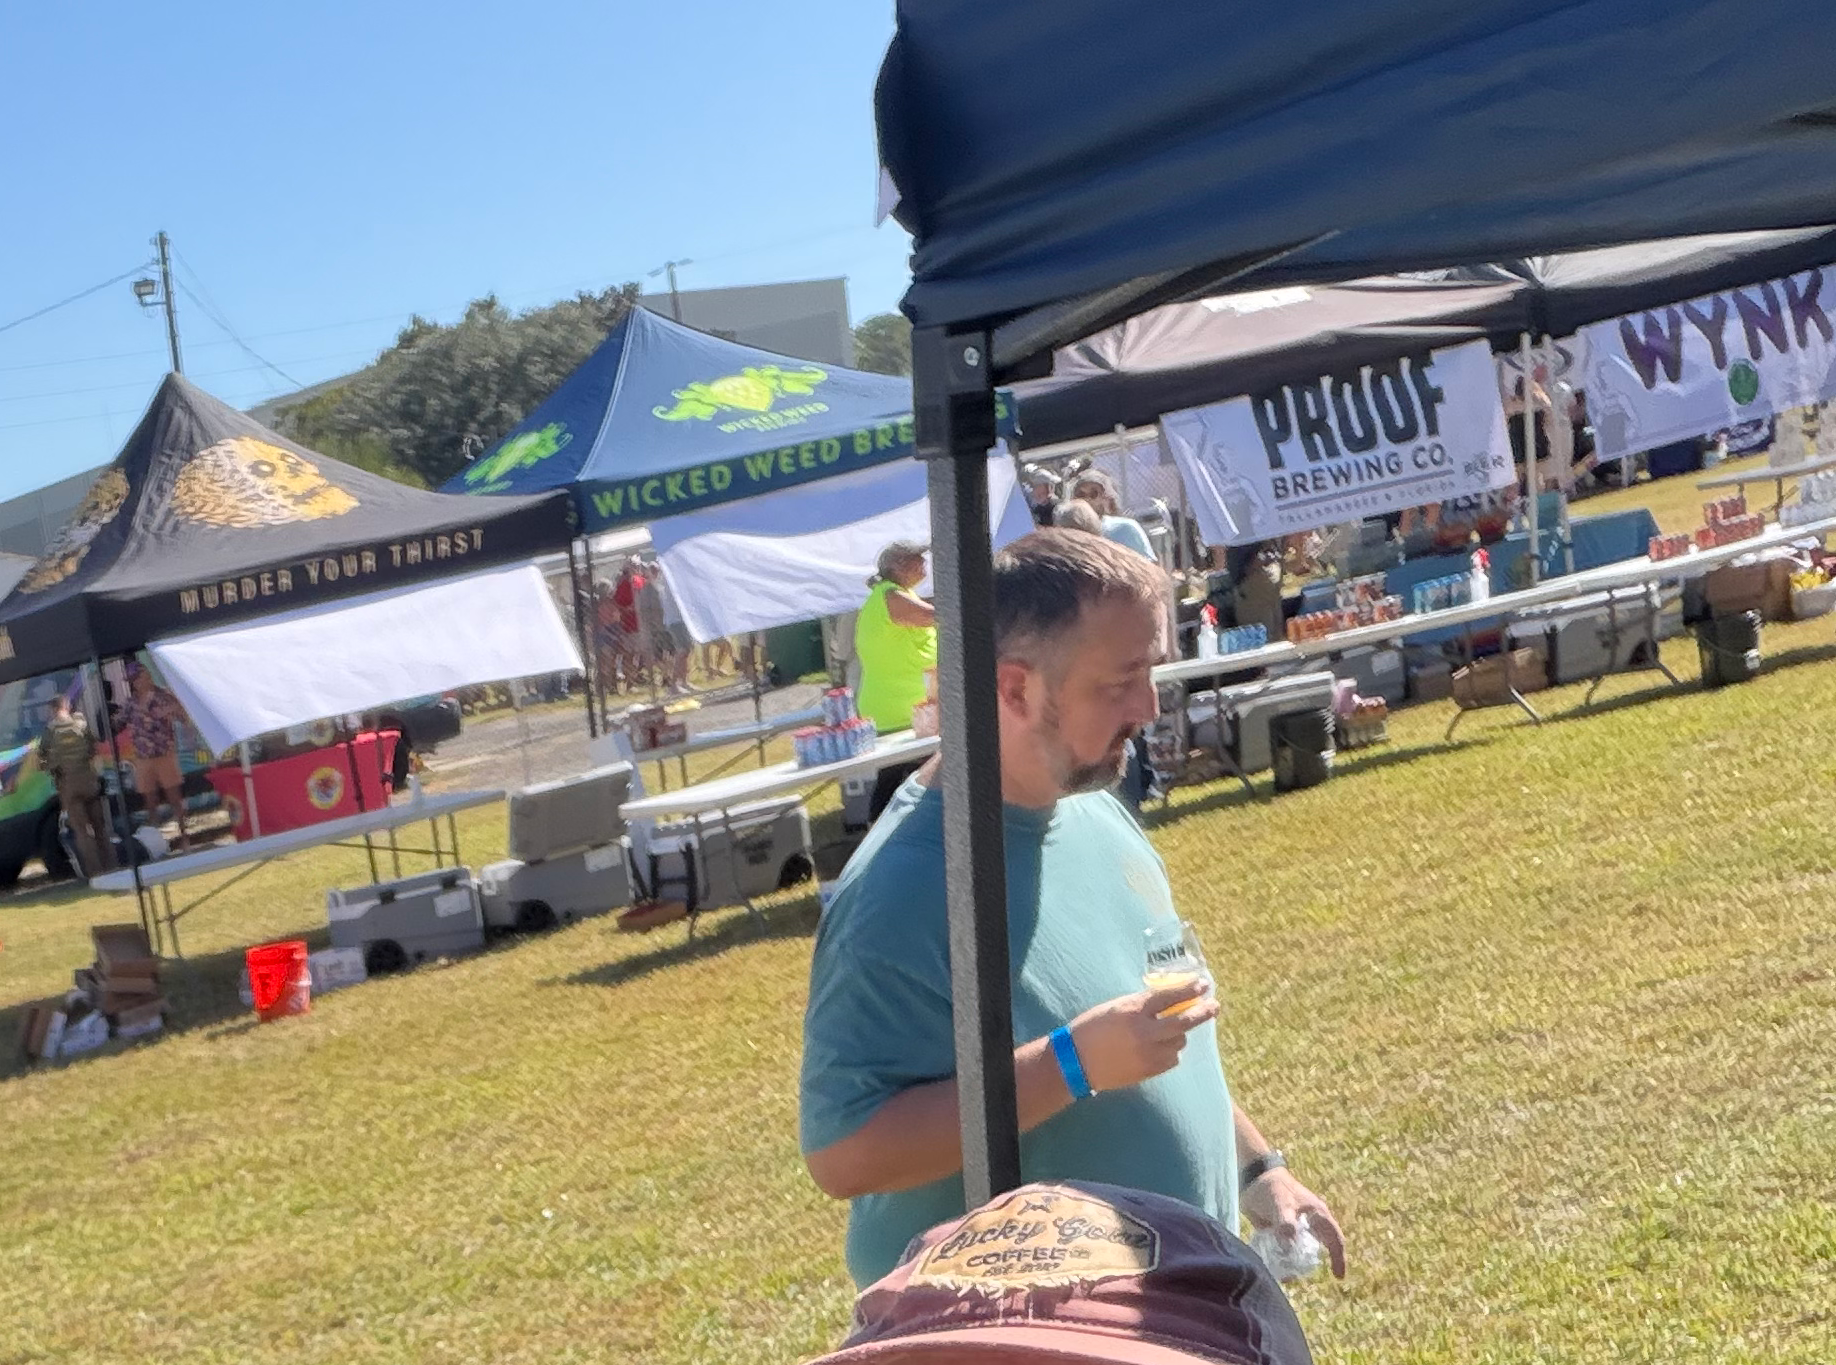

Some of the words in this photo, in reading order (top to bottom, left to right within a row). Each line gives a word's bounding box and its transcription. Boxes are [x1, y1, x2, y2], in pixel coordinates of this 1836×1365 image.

[1619, 268, 1834, 390] WYNK
[1250, 354, 1445, 470] PROOF
[591, 463, 733, 518] WICKED
[743, 438, 842, 482] WEED
[1271, 450, 1404, 500] BREWING
[1412, 442, 1455, 471] CO.
[179, 567, 294, 615] MURDER
[303, 550, 378, 586] YOUR
[388, 527, 485, 568] THIRST
[932, 1217, 1048, 1264] Lucky
[965, 1246, 1069, 1269] COFFEE
